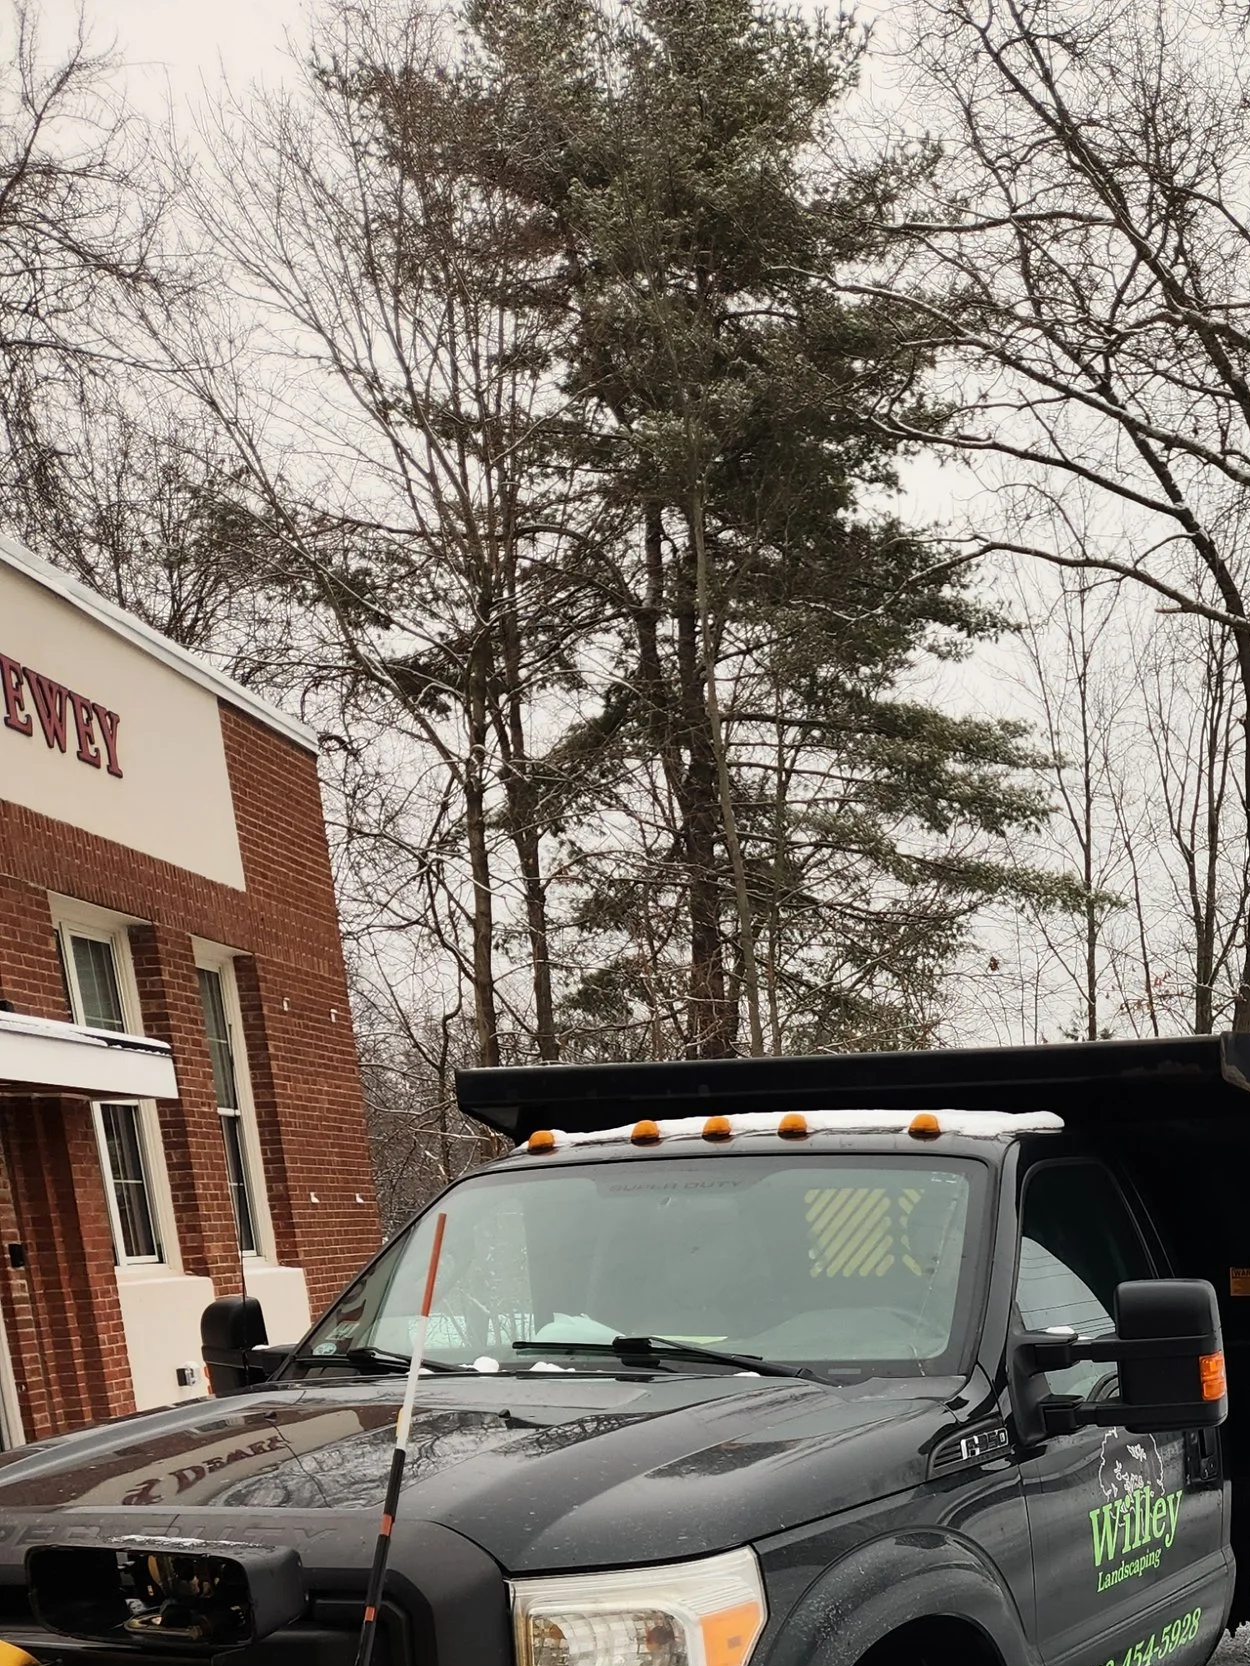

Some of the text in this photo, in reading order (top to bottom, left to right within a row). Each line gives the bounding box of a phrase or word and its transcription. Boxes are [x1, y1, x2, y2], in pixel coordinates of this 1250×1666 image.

[0, 652, 123, 779] EWEY
[1089, 1485, 1183, 1567] Willey
[1096, 1549, 1162, 1593] Landscaping
